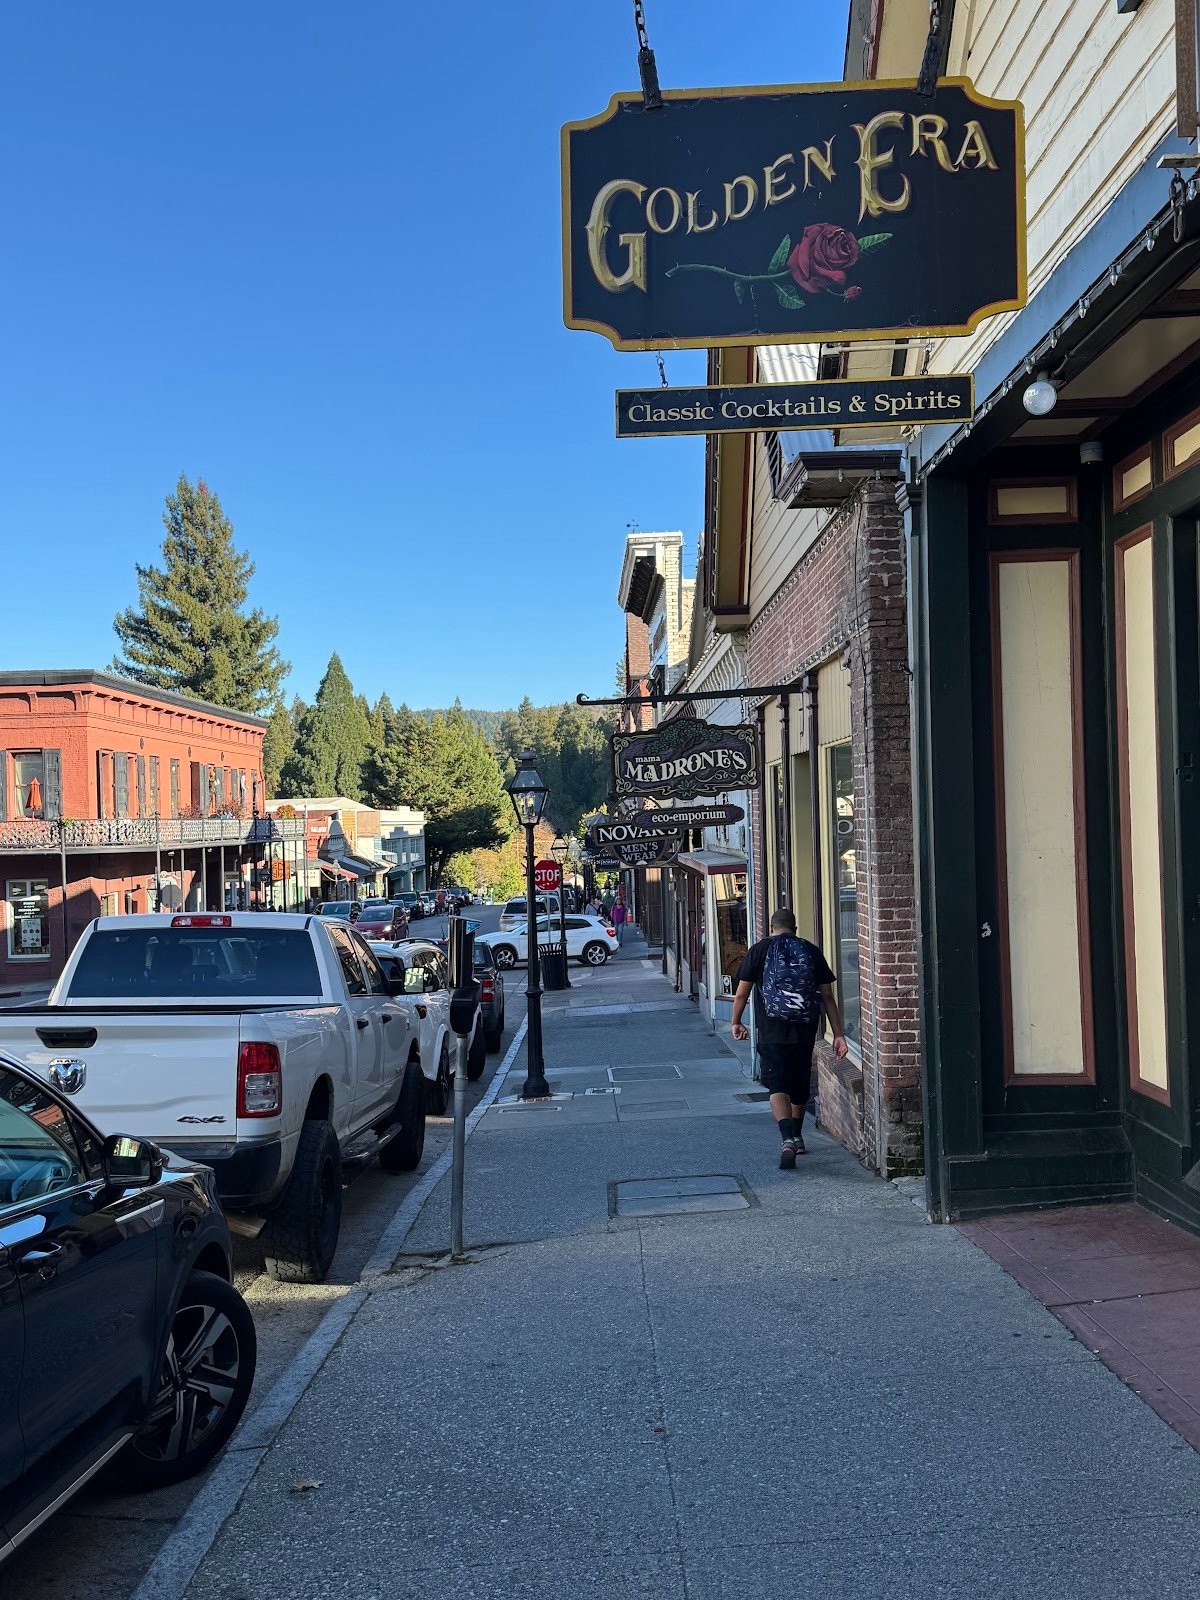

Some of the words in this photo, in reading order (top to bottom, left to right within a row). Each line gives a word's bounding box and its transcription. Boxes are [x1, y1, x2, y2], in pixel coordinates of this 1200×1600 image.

[585, 134, 838, 294] GOLDEN
[850, 110, 999, 225] ERA
[628, 402, 714, 423] Classic
[721, 396, 841, 419] Cocktails
[848, 394, 867, 413] &
[873, 390, 961, 416] Spirits
[624, 748, 748, 783] MADRONE'S
[635, 755, 661, 763] mama
[651, 809, 727, 825] eco-emporium
[598, 824, 678, 842] NOVAKS
[620, 841, 659, 854] MEN'S
[621, 850, 657, 862] WEAR
[534, 869, 561, 882] STOP
